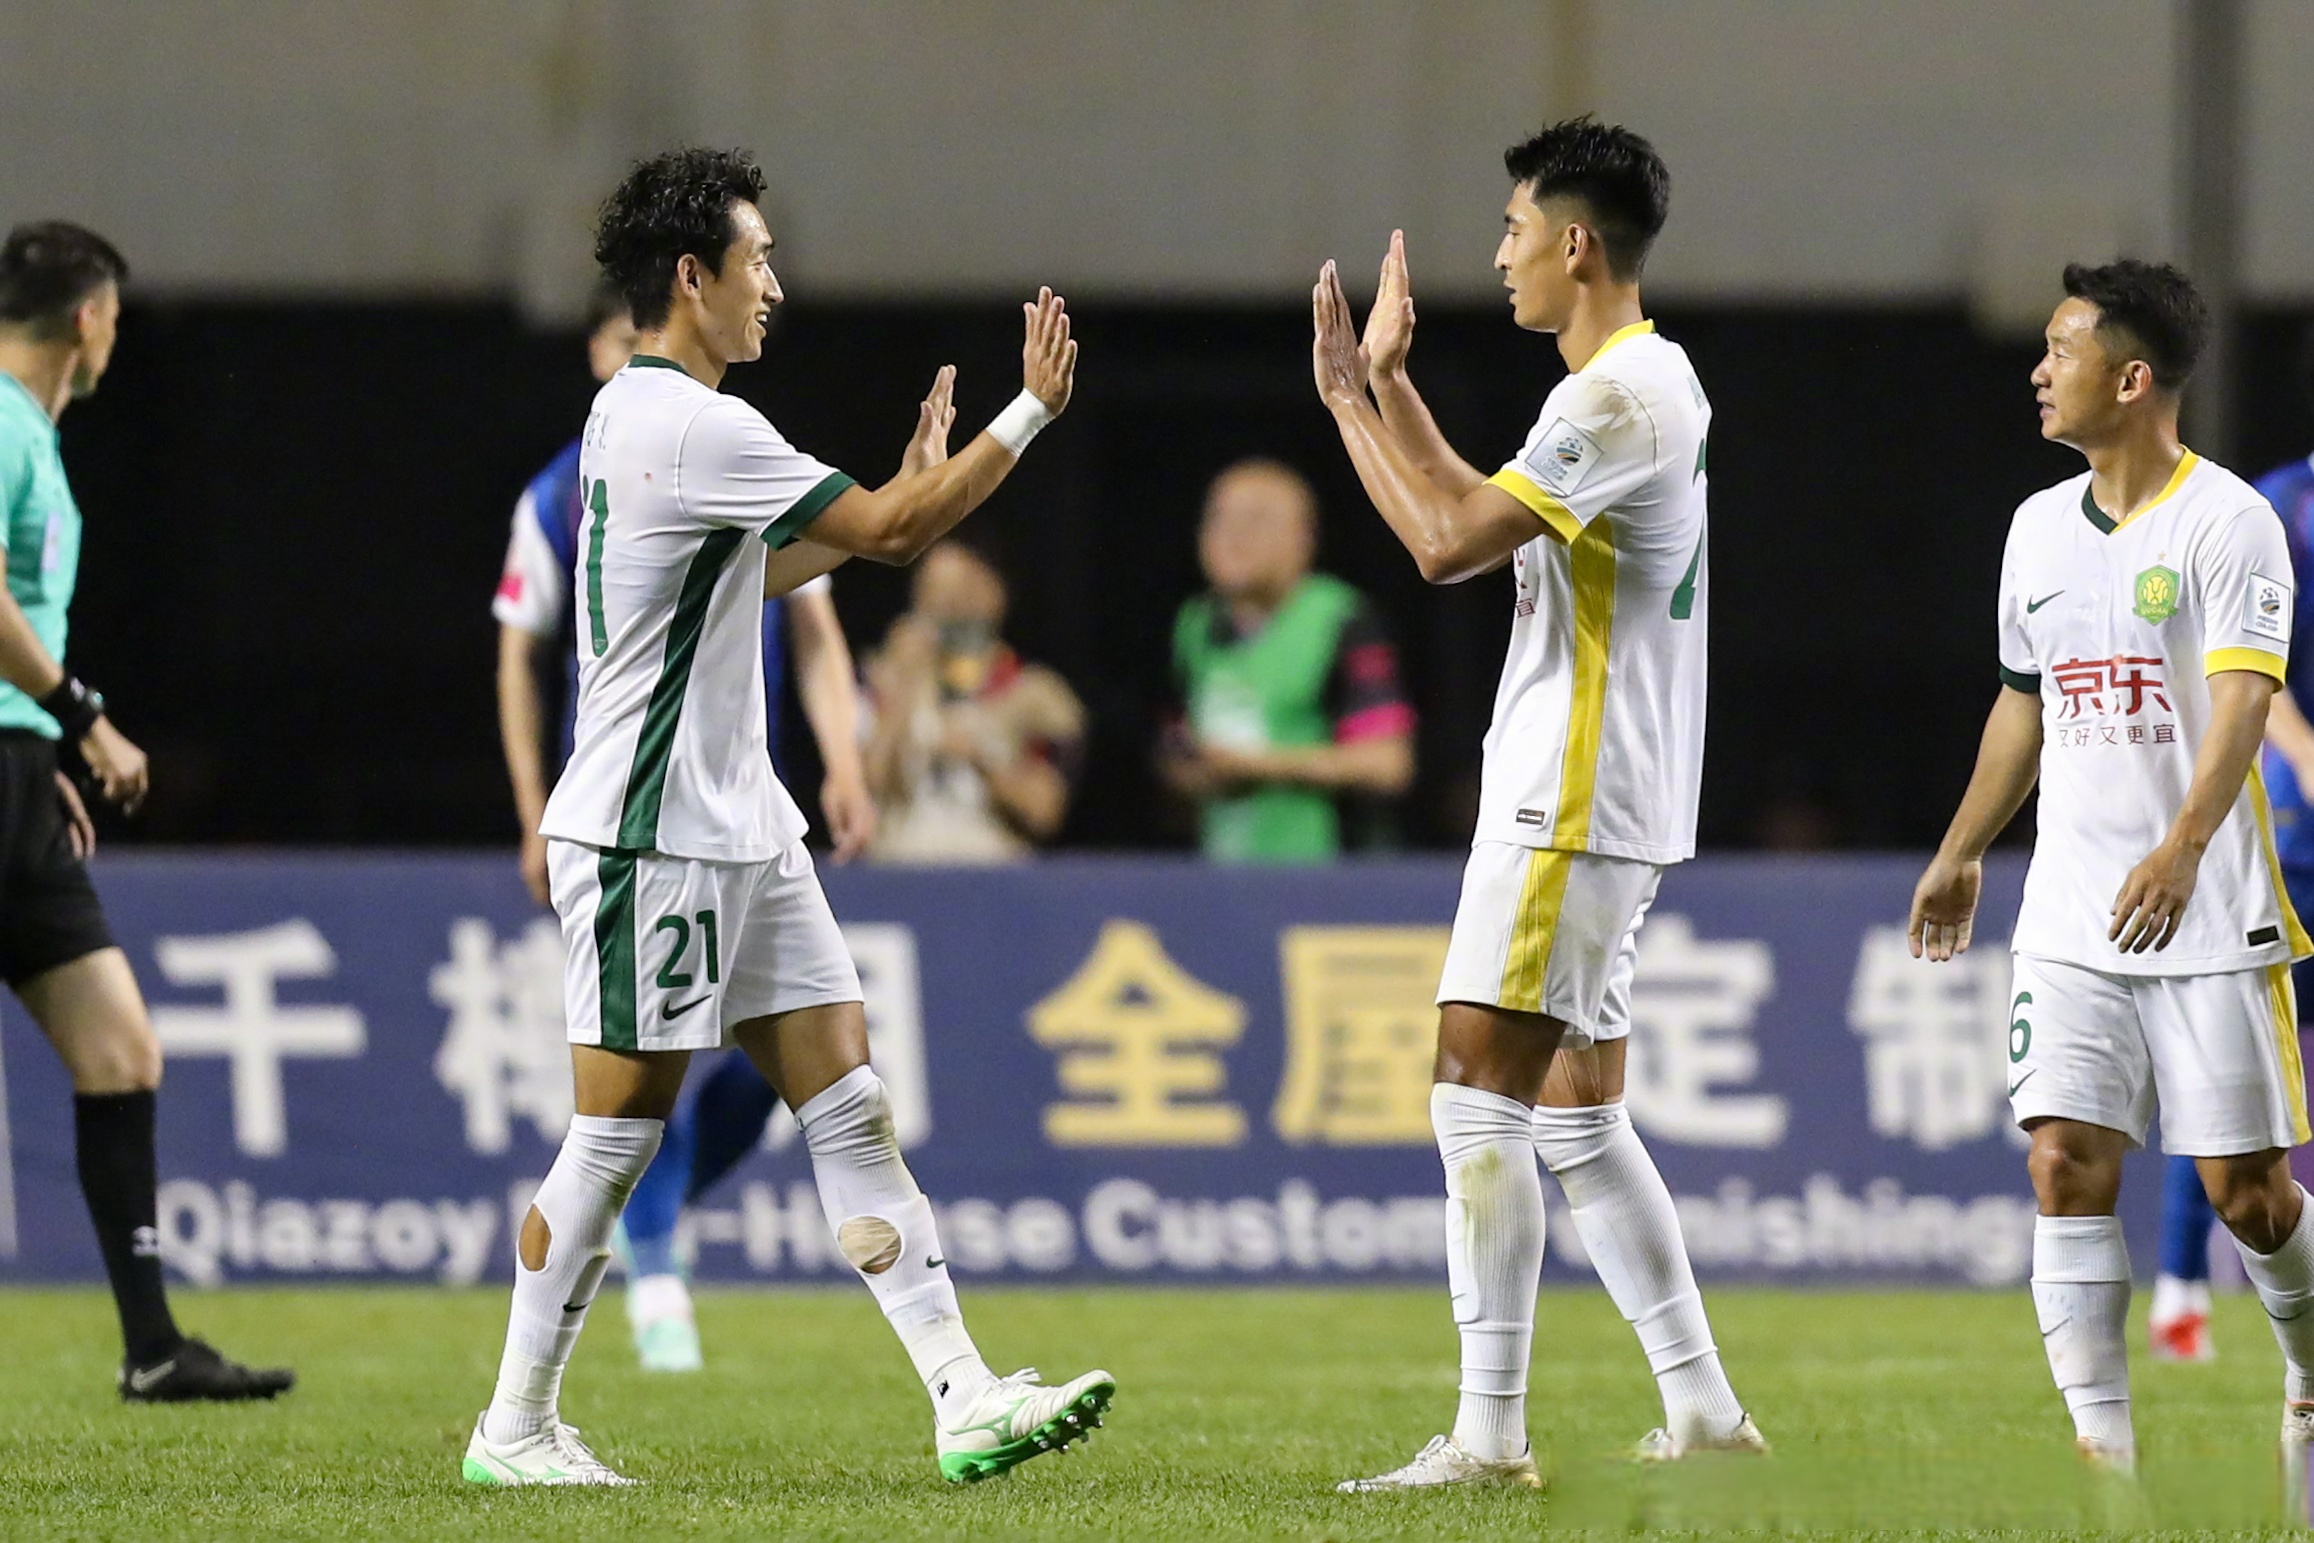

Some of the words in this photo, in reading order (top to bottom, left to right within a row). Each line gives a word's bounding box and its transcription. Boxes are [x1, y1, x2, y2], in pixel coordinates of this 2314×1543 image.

[2051, 654, 2173, 719] 京东
[656, 909, 719, 989] 21
[155, 1178, 500, 1287] Qiazoy
